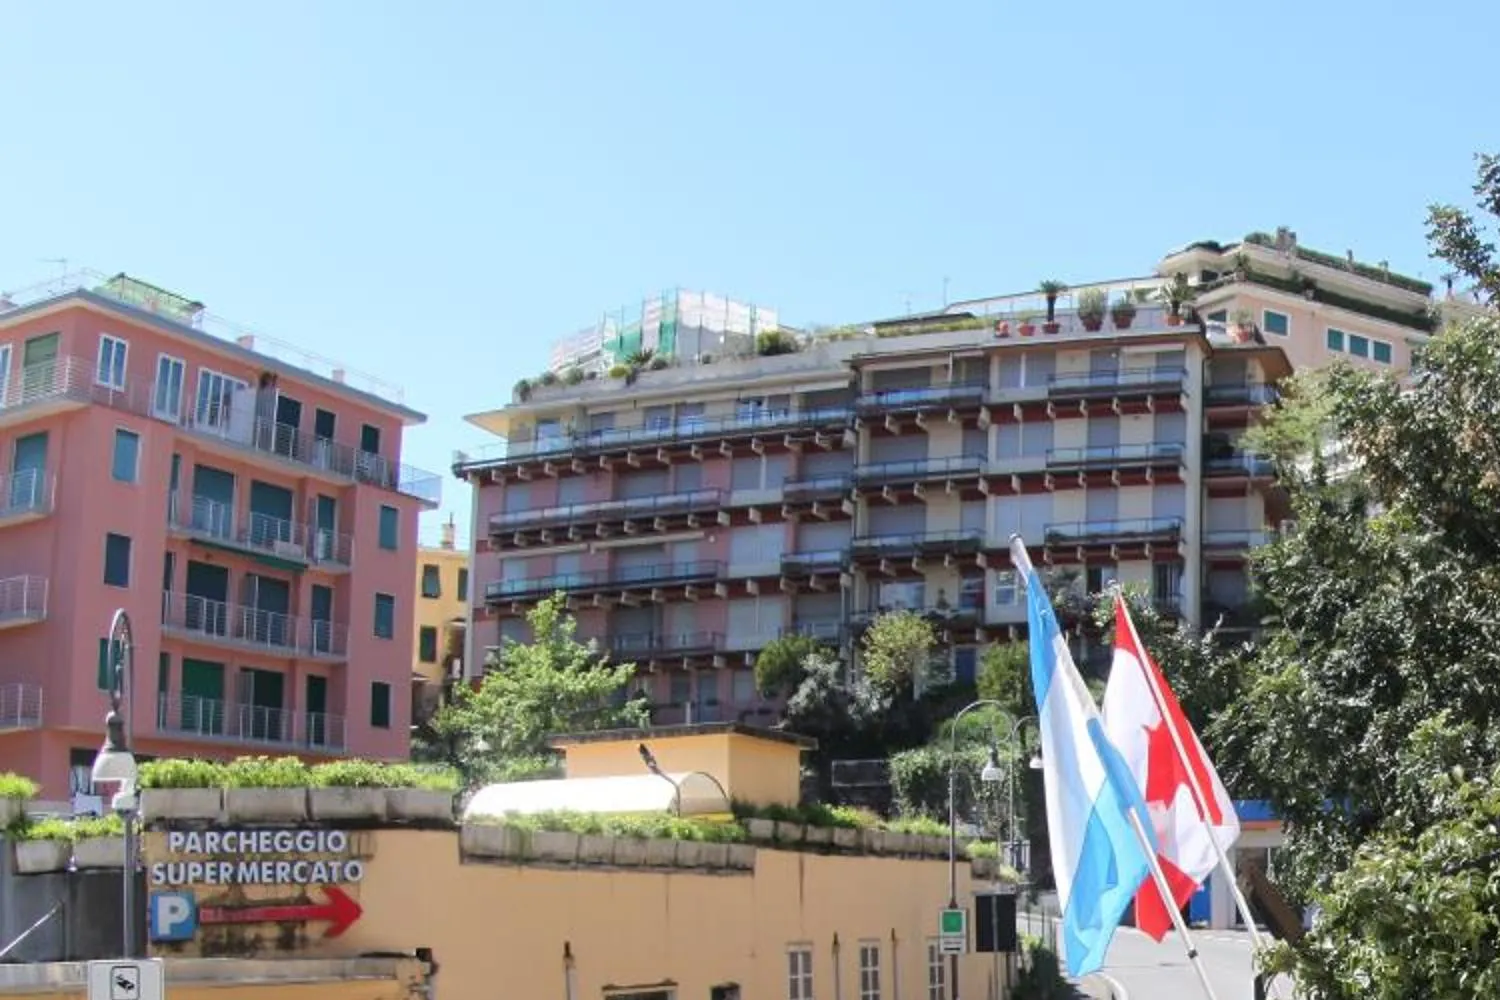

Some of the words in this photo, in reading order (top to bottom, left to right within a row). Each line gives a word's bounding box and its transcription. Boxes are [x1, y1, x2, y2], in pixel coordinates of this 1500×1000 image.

[168, 829, 347, 854] PARCHEGGIO
[151, 860, 364, 885] SUPERMERCATO
[156, 894, 190, 937] P
